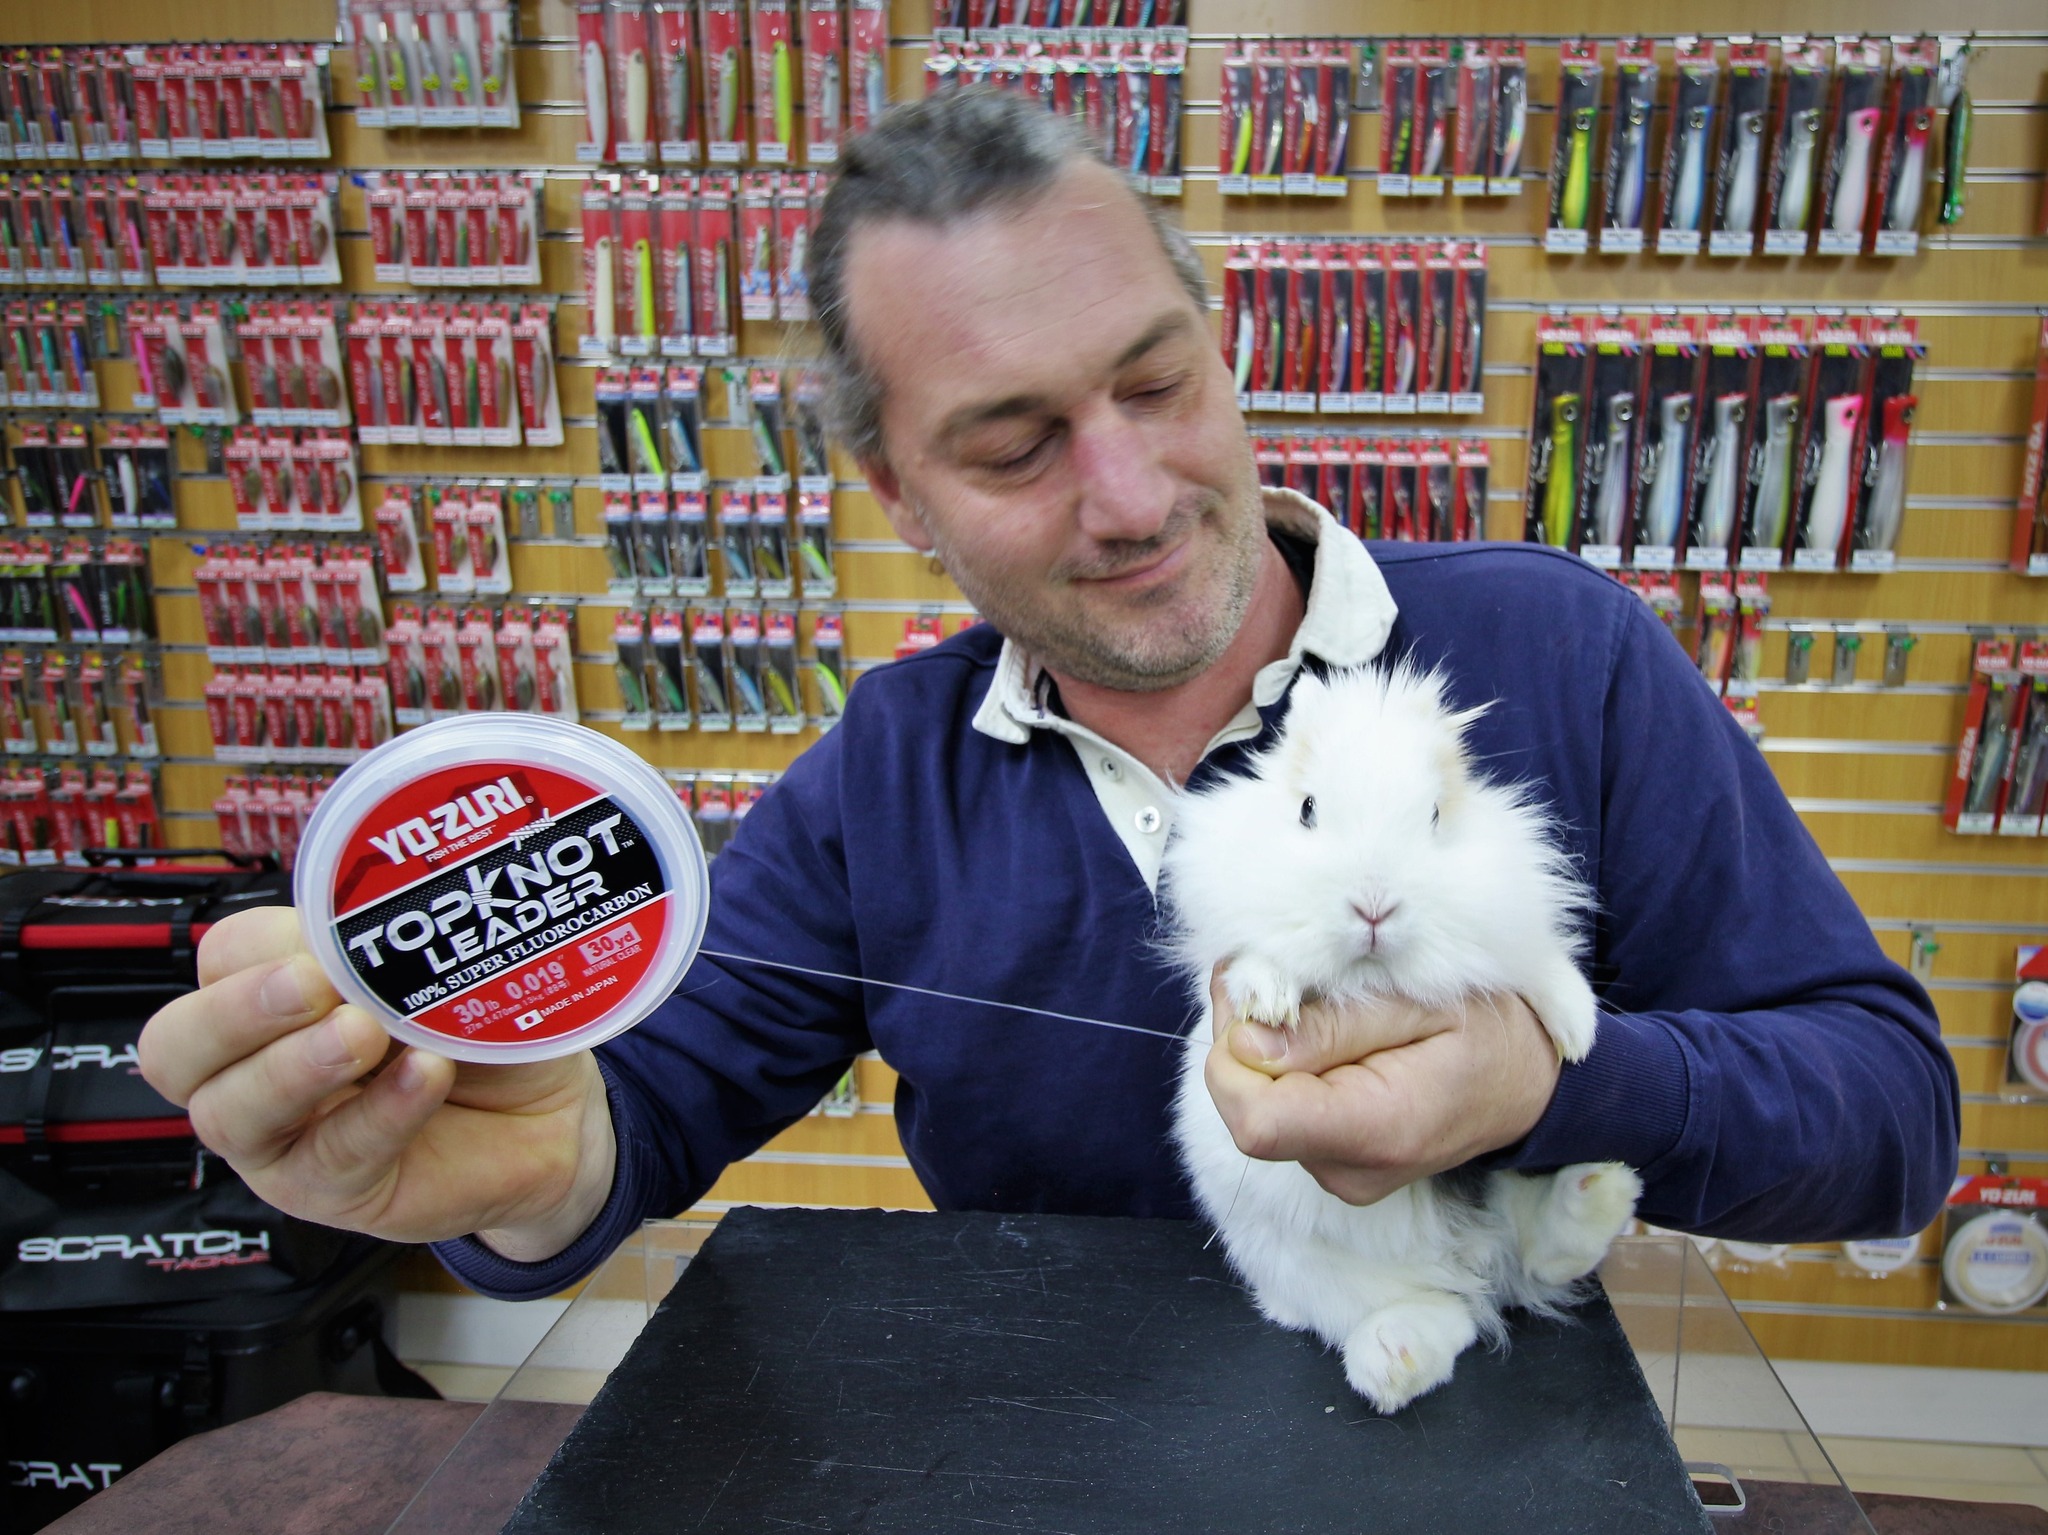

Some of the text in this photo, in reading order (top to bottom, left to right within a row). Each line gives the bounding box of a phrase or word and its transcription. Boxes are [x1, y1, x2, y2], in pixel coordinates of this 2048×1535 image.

[368, 776, 526, 865] YO-ZURI
[426, 826, 494, 863] FISH THE BEST
[349, 813, 622, 968] TOPKNOT
[424, 871, 609, 975] LEADER
[403, 882, 654, 1011] 100% SUPER FLUOROCARBON
[582, 944, 643, 977] NATURAL CLEAR
[540, 975, 619, 1017] MADE IN JAPAN
[0, 1043, 139, 1073] SCRA
[18, 1230, 270, 1262] SCRATCH
[146, 1251, 271, 1272] TACKLE
[8, 1460, 122, 1490] CRAT
